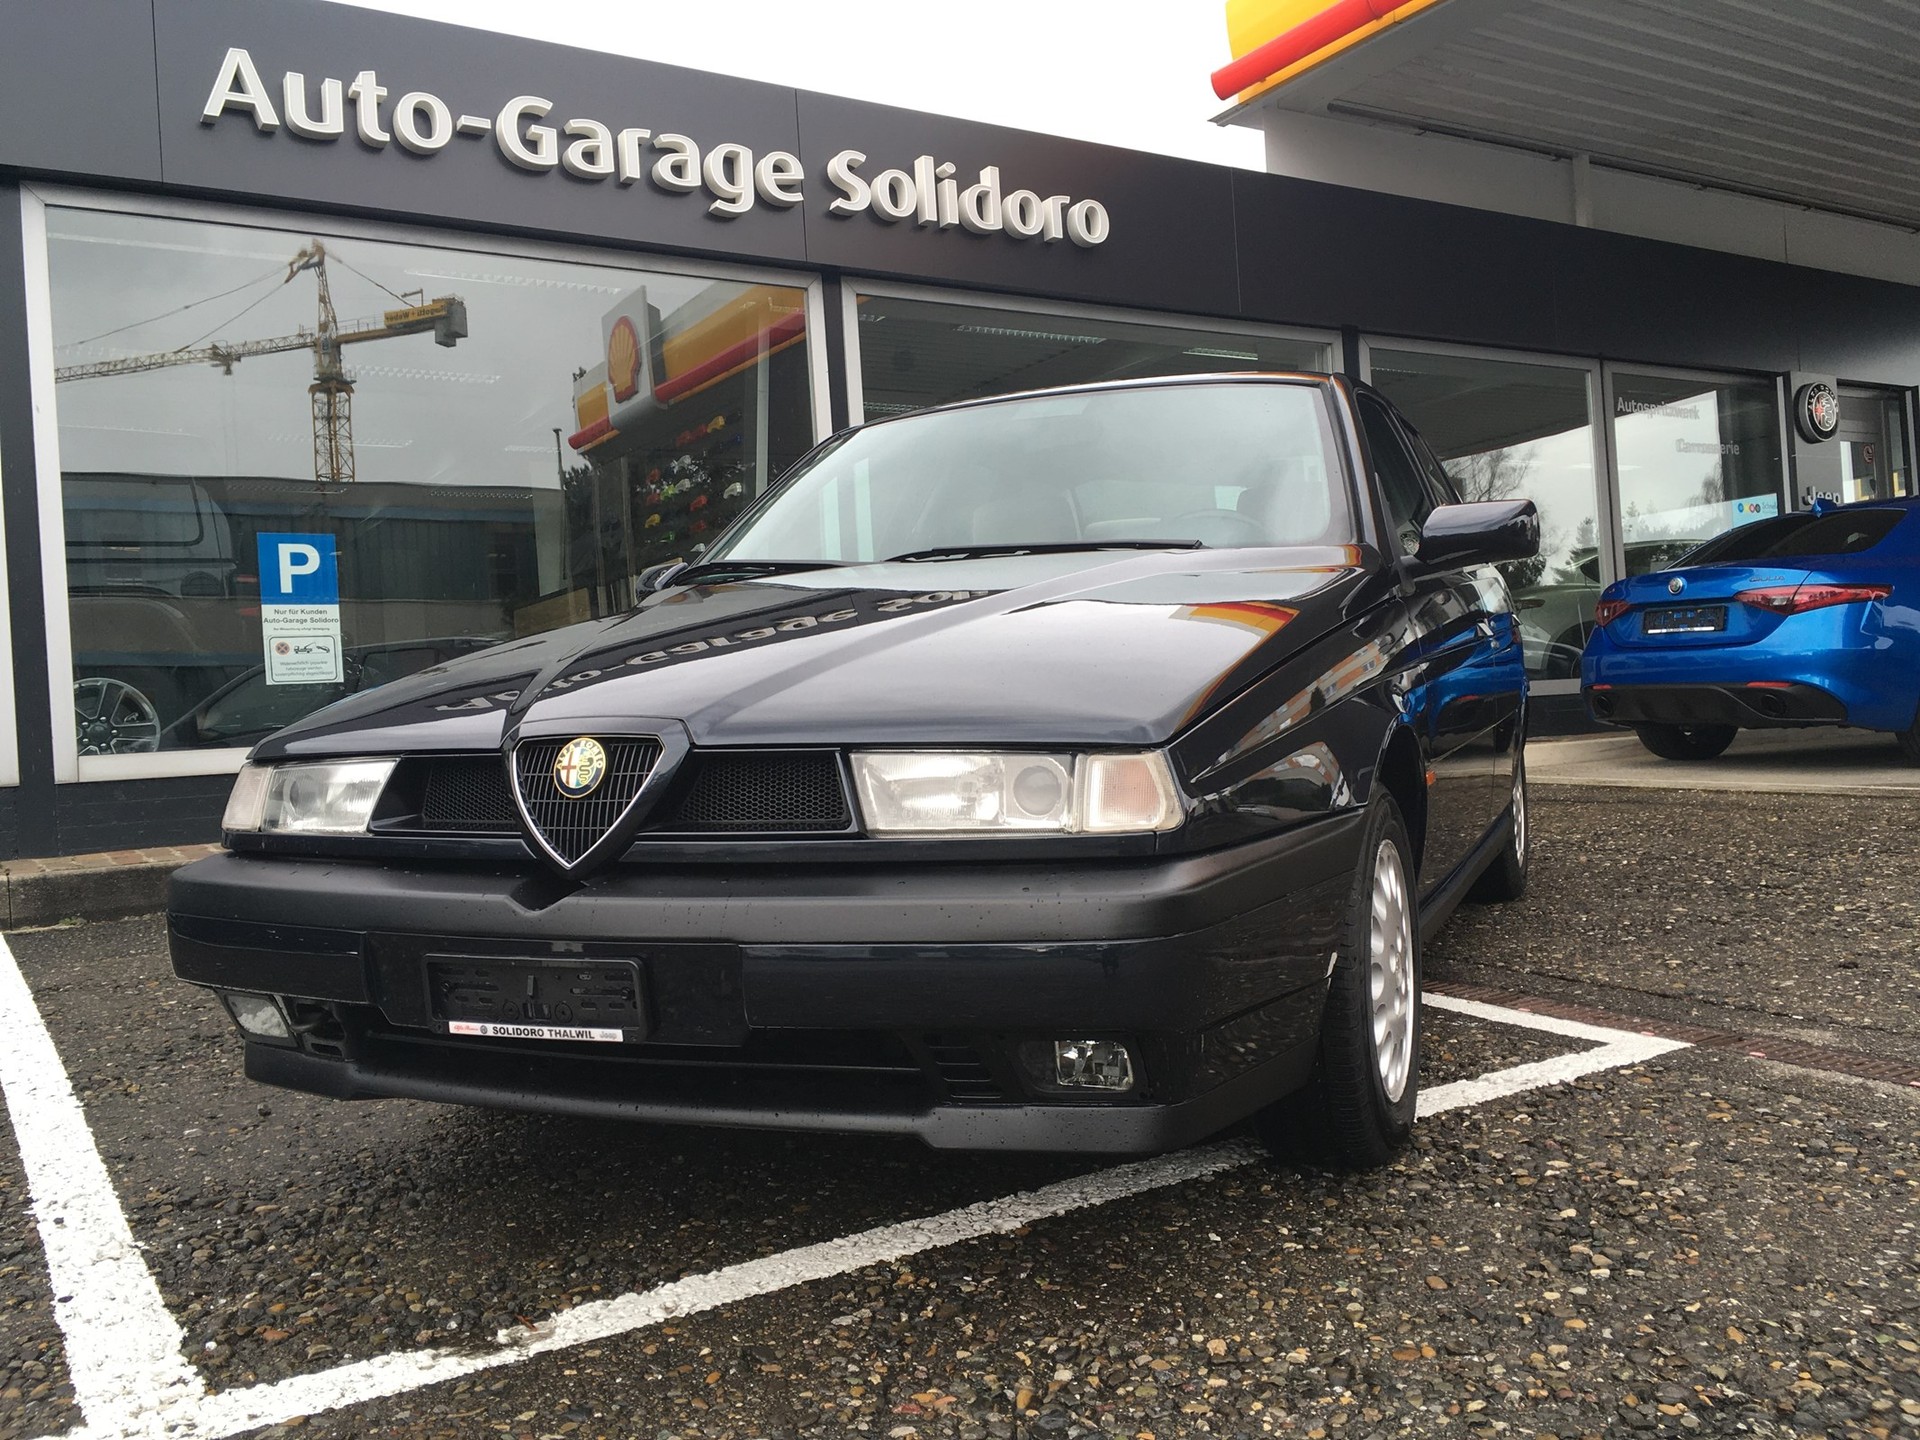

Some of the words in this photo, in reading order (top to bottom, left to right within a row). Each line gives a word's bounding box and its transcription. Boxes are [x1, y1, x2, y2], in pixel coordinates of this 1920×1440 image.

[200, 47, 804, 218] Auto-Garage
[827, 149, 1110, 248] Solidoro
[278, 543, 320, 593] P
[263, 617, 308, 625] Auto-Garage
[309, 616, 339, 624] Solidoro
[579, 740, 604, 769] ROMEO
[492, 1026, 545, 1038] SOLIDORO
[547, 1029, 596, 1040] THALWIL
